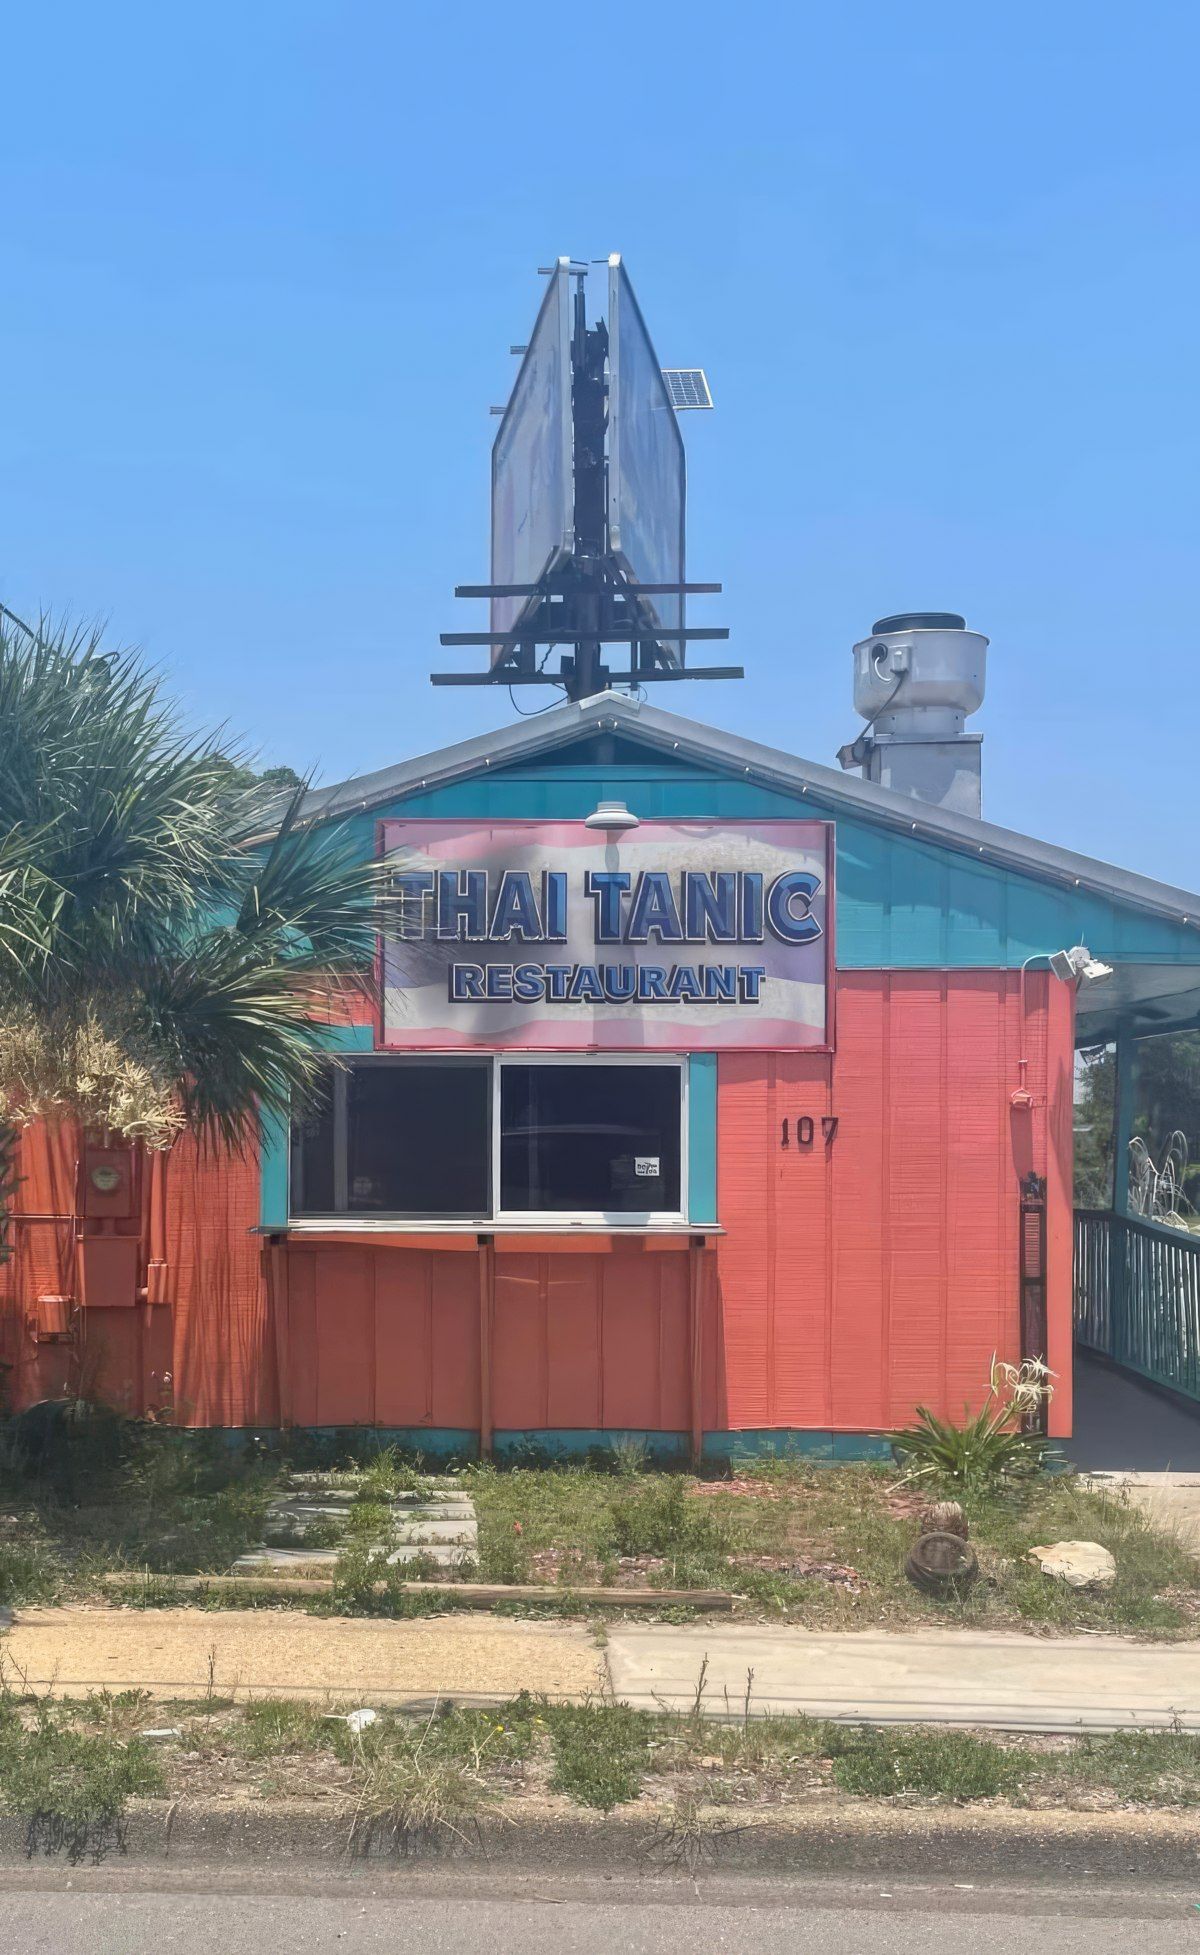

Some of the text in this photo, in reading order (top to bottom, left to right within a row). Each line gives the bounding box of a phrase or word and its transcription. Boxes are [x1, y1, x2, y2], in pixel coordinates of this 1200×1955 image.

[389, 870, 824, 945] THAI TANIC
[449, 963, 766, 1005] RESTAURANT
[781, 1116, 839, 1147] 107
